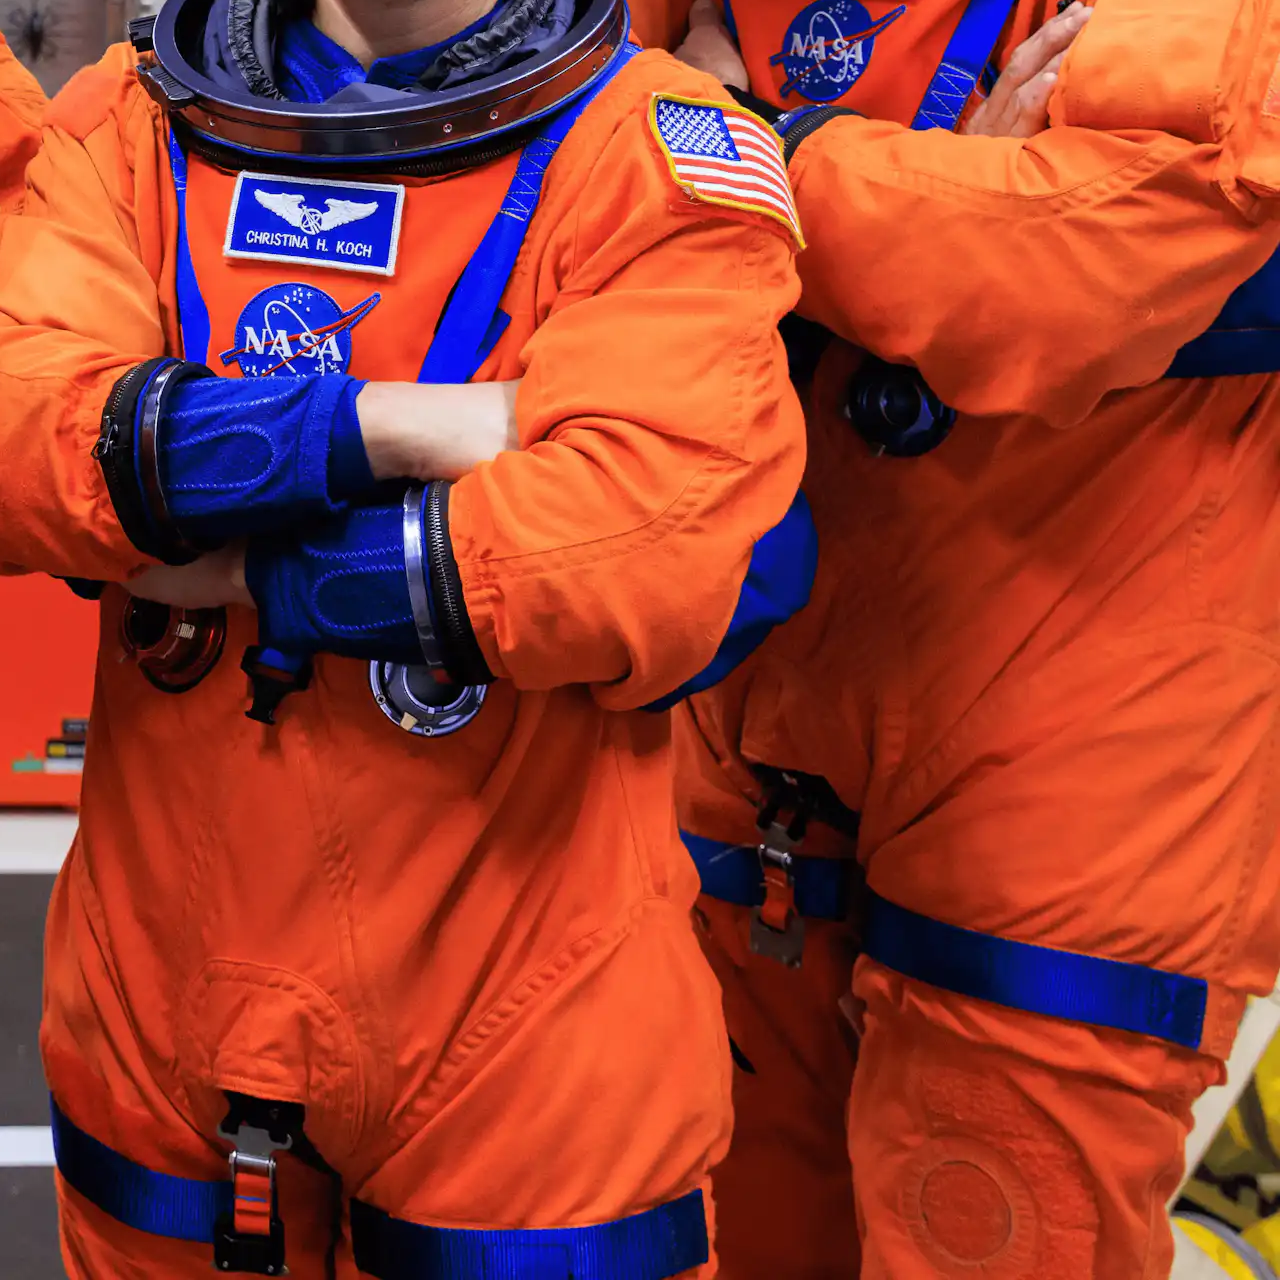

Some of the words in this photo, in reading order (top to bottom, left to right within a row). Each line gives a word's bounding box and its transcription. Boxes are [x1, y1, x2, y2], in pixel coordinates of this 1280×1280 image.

[790, 32, 864, 65] NASA
[246, 230, 309, 250] CHRISTINA
[316, 238, 328, 252] H.
[336, 241, 372, 258] KOCH
[244, 326, 343, 362] NASA
